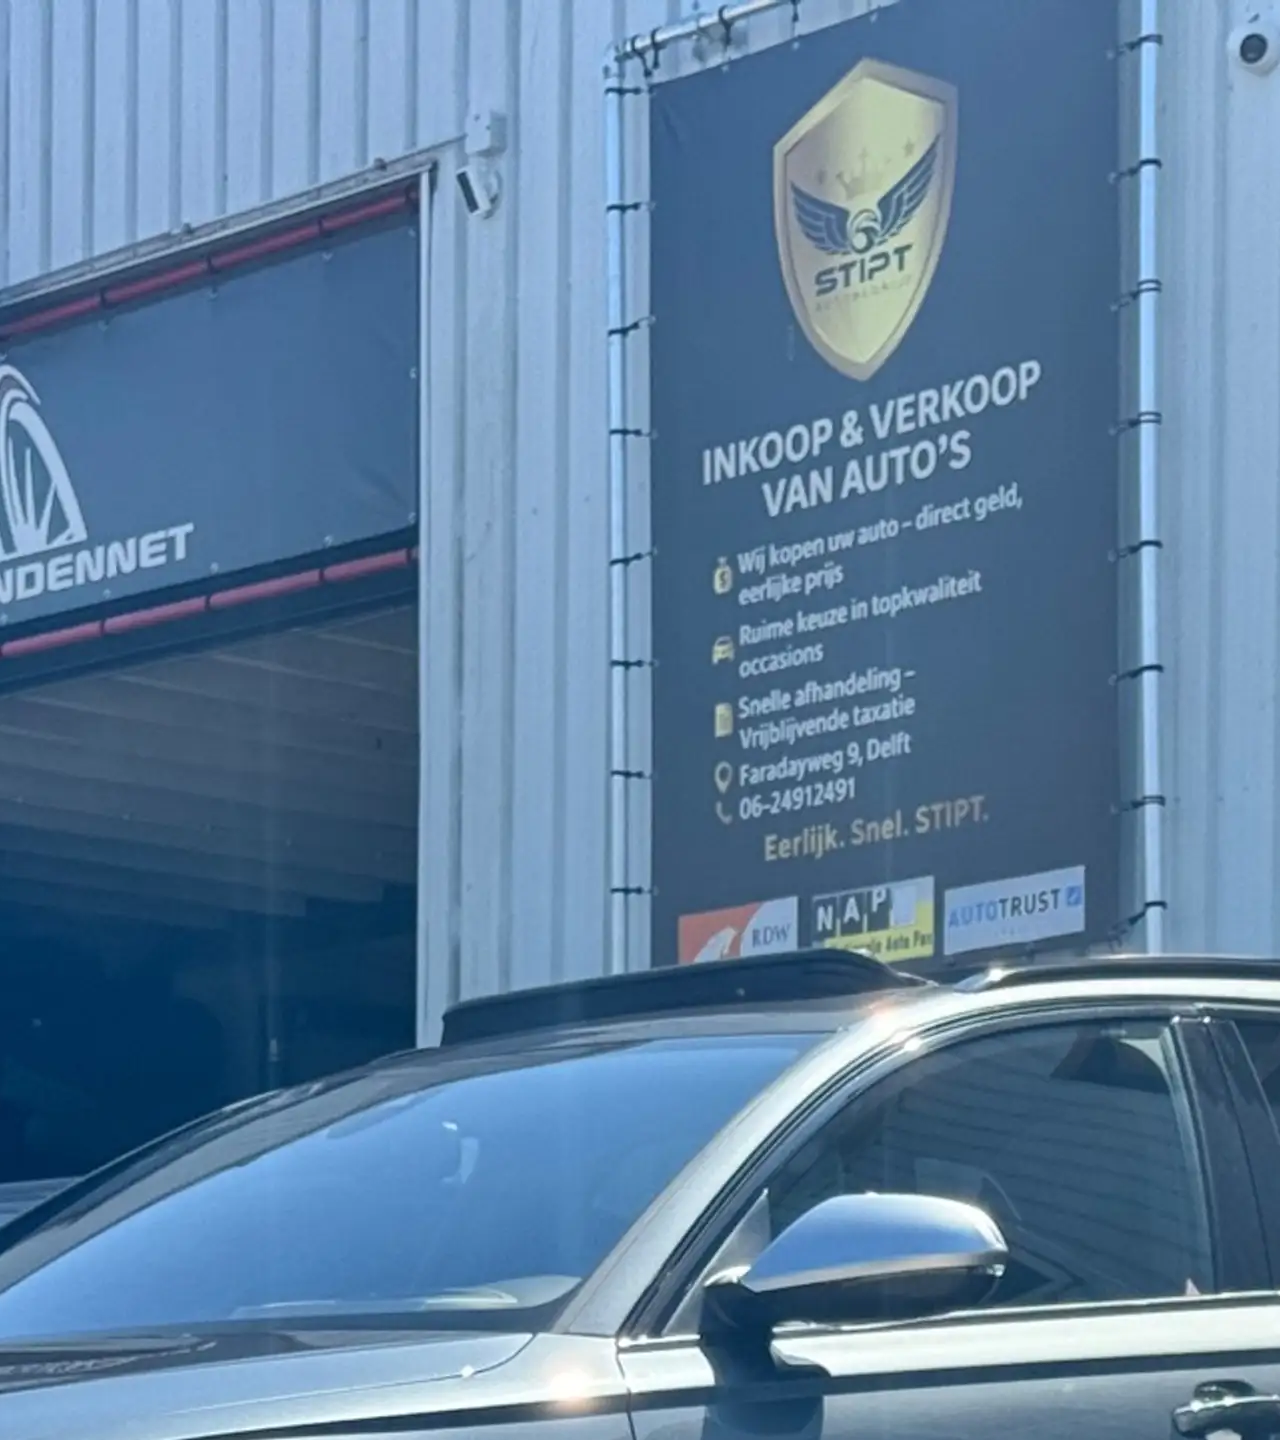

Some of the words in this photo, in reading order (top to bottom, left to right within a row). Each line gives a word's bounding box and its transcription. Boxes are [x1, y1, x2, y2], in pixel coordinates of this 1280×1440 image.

[814, 243, 913, 298] STIPT
[703, 417, 832, 486] INKOOP
[839, 409, 863, 448] &
[869, 360, 1041, 440] VERKOOP
[761, 465, 833, 518] VAN
[839, 429, 972, 499] AUTO'S
[737, 544, 766, 575] Wij
[769, 537, 824, 567] kopen
[827, 527, 855, 553] uw
[857, 517, 899, 546] auto
[915, 497, 970, 531] direct
[974, 481, 1023, 522] geld,
[738, 571, 802, 606] eerlijke
[804, 561, 844, 596] prijs
[739, 619, 793, 646] Ruime
[797, 610, 848, 634] keuze
[851, 598, 868, 621] in
[871, 569, 982, 618] topkwaliteit
[738, 643, 823, 678] occasions
[737, 688, 792, 720] Snelle
[794, 667, 901, 708] afhandeling
[738, 708, 849, 751] Vrijblijvende
[853, 693, 916, 728] taxatie
[739, 749, 843, 787] Faradayweg
[846, 742, 864, 768] 9,
[867, 731, 912, 762] Delft
[739, 776, 856, 821] 06-24912491
[764, 823, 844, 862] Eerlijk.
[851, 809, 909, 845] Snel.
[915, 795, 989, 834] STIPT.
[752, 923, 791, 948] RDW
[948, 888, 1061, 928] AUTOTRUST
